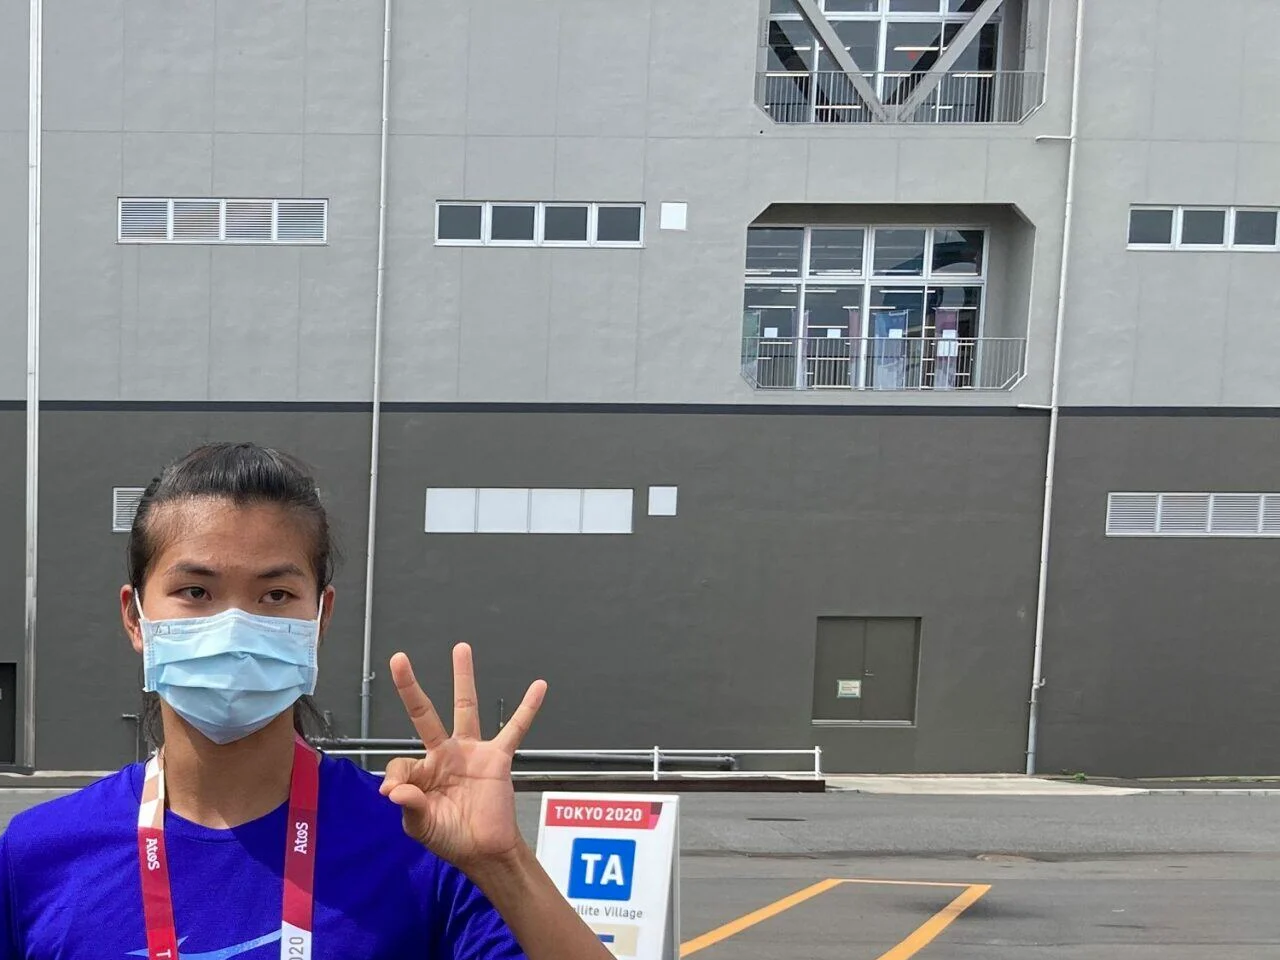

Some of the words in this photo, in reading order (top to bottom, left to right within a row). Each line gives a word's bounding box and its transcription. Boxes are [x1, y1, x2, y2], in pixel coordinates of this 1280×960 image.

[554, 805, 603, 820] TOKYO
[605, 807, 643, 822] 2020
[145, 837, 160, 871] Atos
[294, 821, 309, 854] Atos
[580, 853, 624, 886] TA
[604, 906, 643, 920] Village
